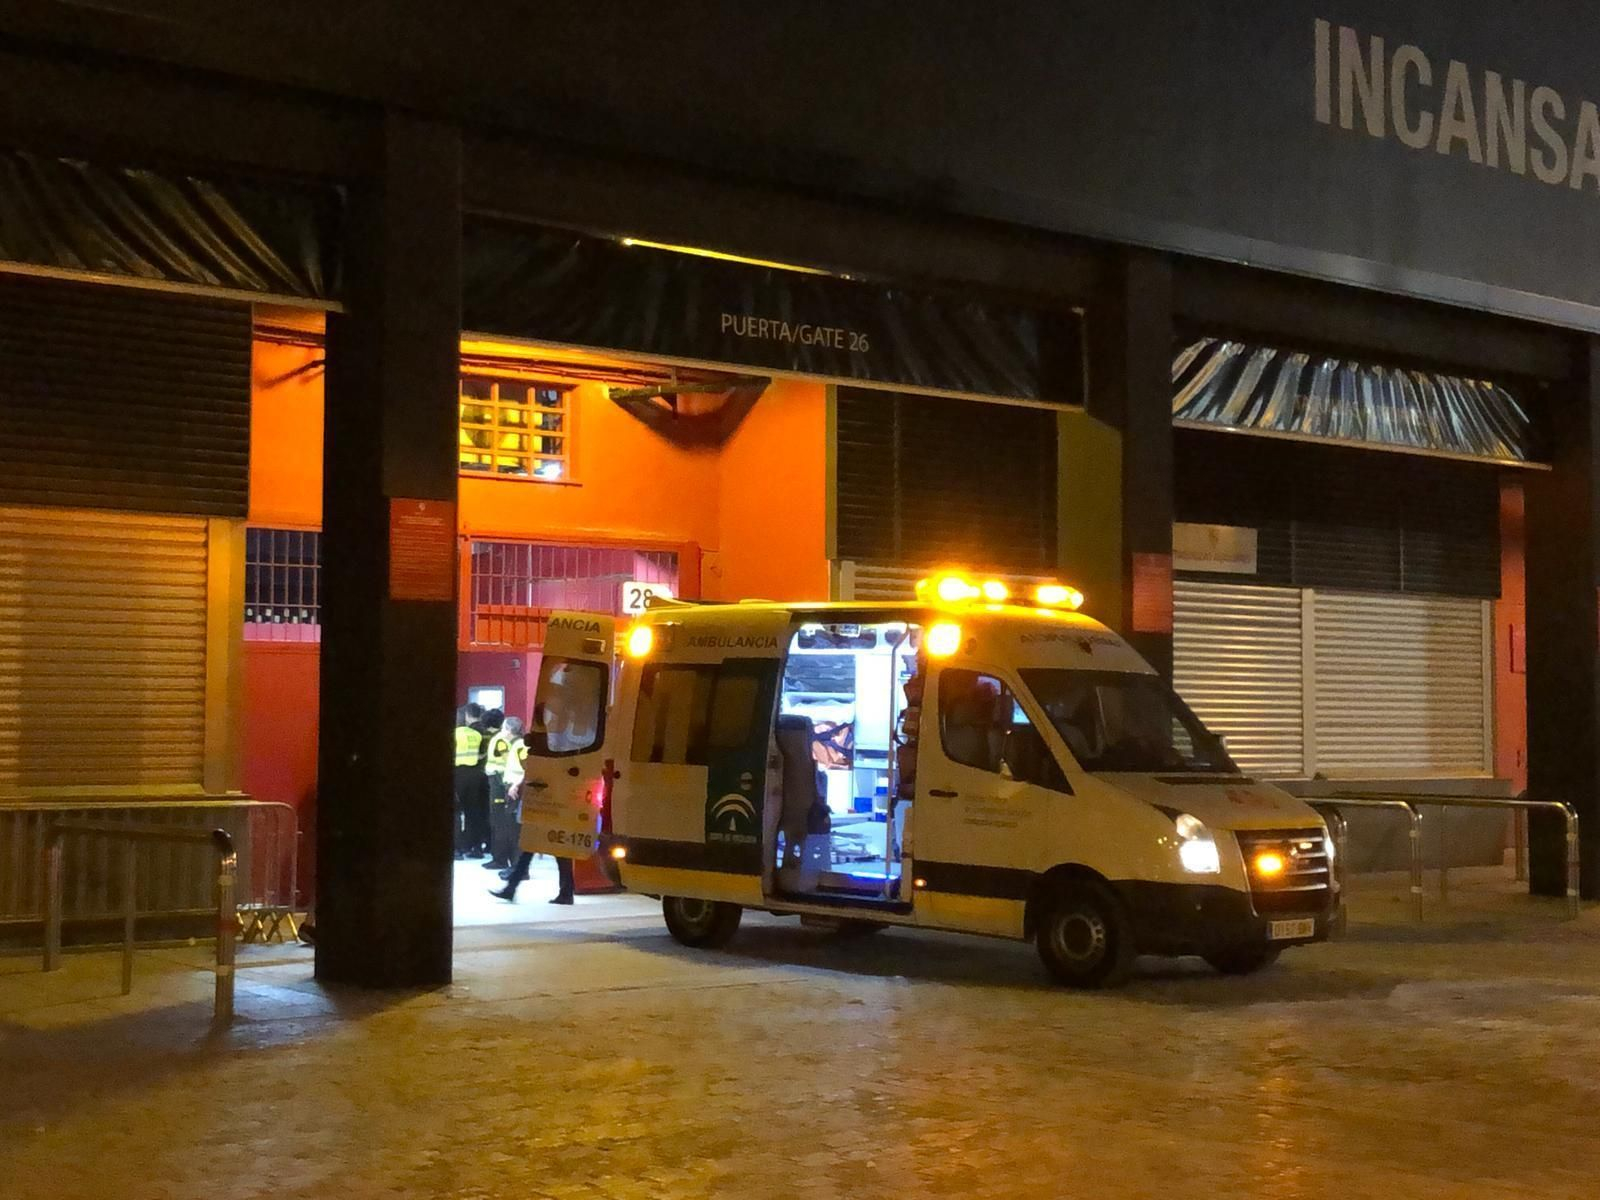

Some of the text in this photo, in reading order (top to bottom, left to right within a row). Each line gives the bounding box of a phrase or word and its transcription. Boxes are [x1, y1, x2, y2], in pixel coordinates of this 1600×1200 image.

[1314, 17, 1600, 194] INCANSA
[721, 313, 869, 352] PUERTA/GATE 26
[630, 588, 653, 608] 28
[549, 617, 600, 634] ANCIA
[687, 635, 778, 649] AMBULANCIA
